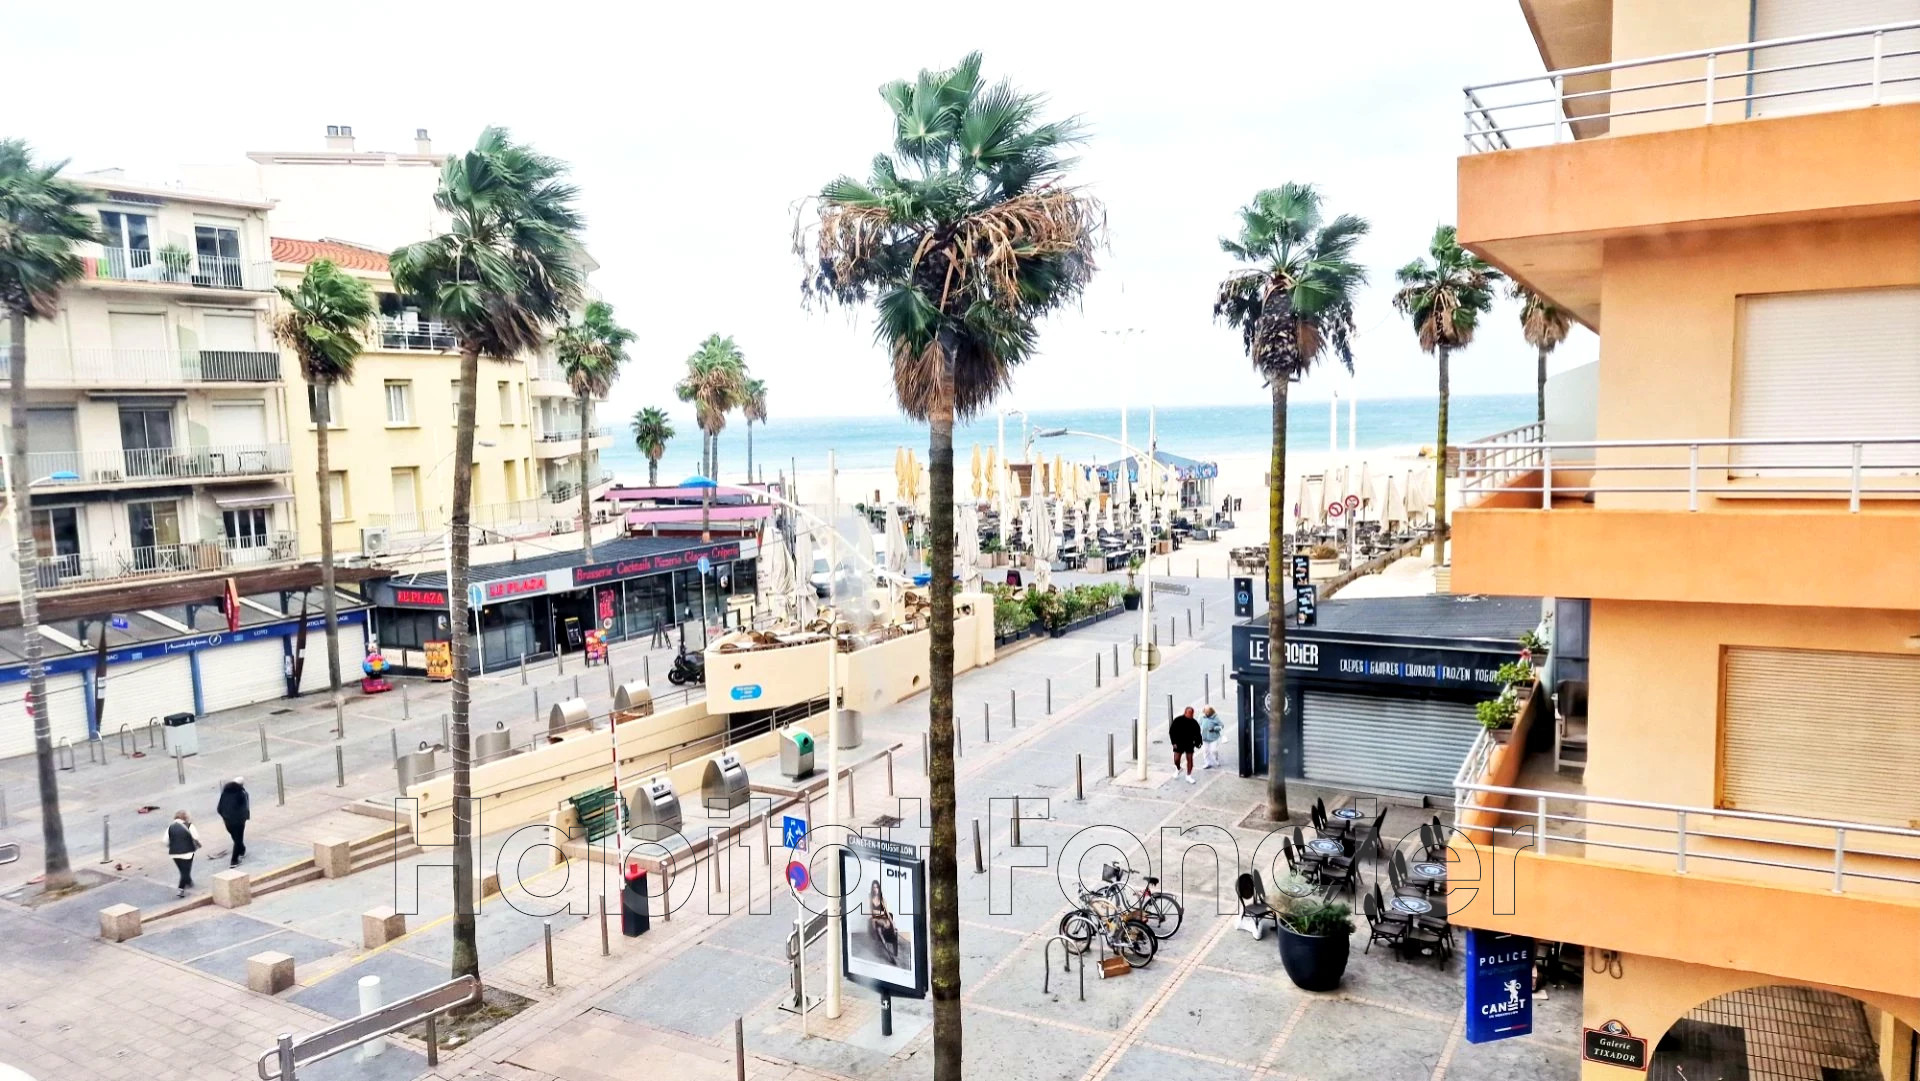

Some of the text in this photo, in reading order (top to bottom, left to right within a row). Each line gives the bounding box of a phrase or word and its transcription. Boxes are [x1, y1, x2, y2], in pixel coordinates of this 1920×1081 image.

[576, 566, 613, 581] Brasserie
[490, 578, 545, 597] LE PLAZA
[397, 591, 445, 604] LE PLAZA
[1250, 640, 1264, 660] LE
[1370, 661, 1399, 675] GAUFRES
[1405, 664, 1436, 677] CHURROS
[1442, 666, 1471, 681] FROZEN
[886, 868, 907, 880] DIM
[1479, 950, 1527, 967] POLICE
[1599, 1038, 1631, 1050] Galerie
[1593, 1047, 1636, 1062] TIXADOR
